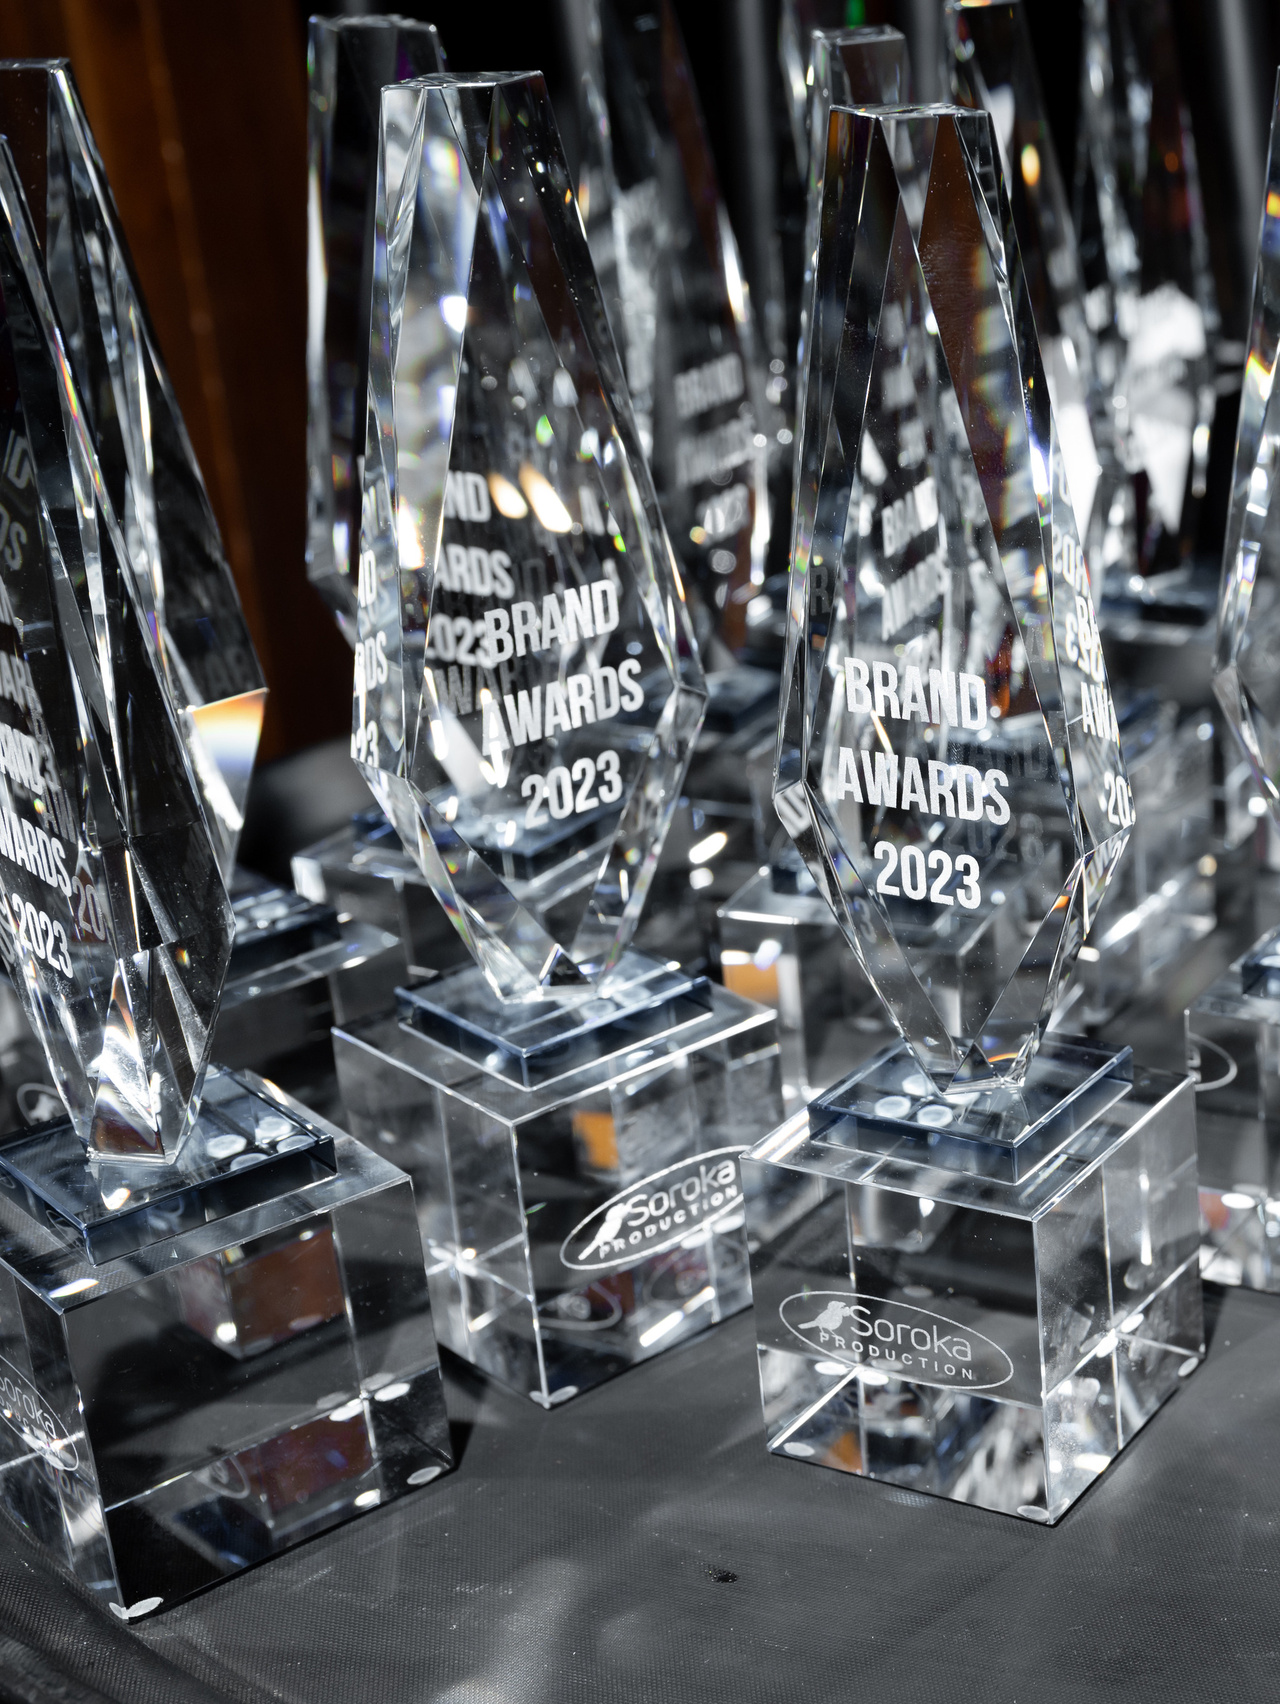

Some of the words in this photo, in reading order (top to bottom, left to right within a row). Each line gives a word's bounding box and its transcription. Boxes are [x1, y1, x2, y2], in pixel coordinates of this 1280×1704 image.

[484, 579, 620, 663] BRAND
[482, 658, 644, 756] AWARDS
[844, 657, 988, 731] BRAND
[521, 750, 623, 830] 2023
[836, 747, 1011, 826] AWARDS
[874, 840, 982, 911] 2023
[11, 892, 74, 979] 2023
[599, 1184, 738, 1260] PRODUCTION
[627, 1158, 737, 1228] Soroka
[819, 1331, 975, 1381] PRODUCTION
[849, 1304, 973, 1362] Soroka
